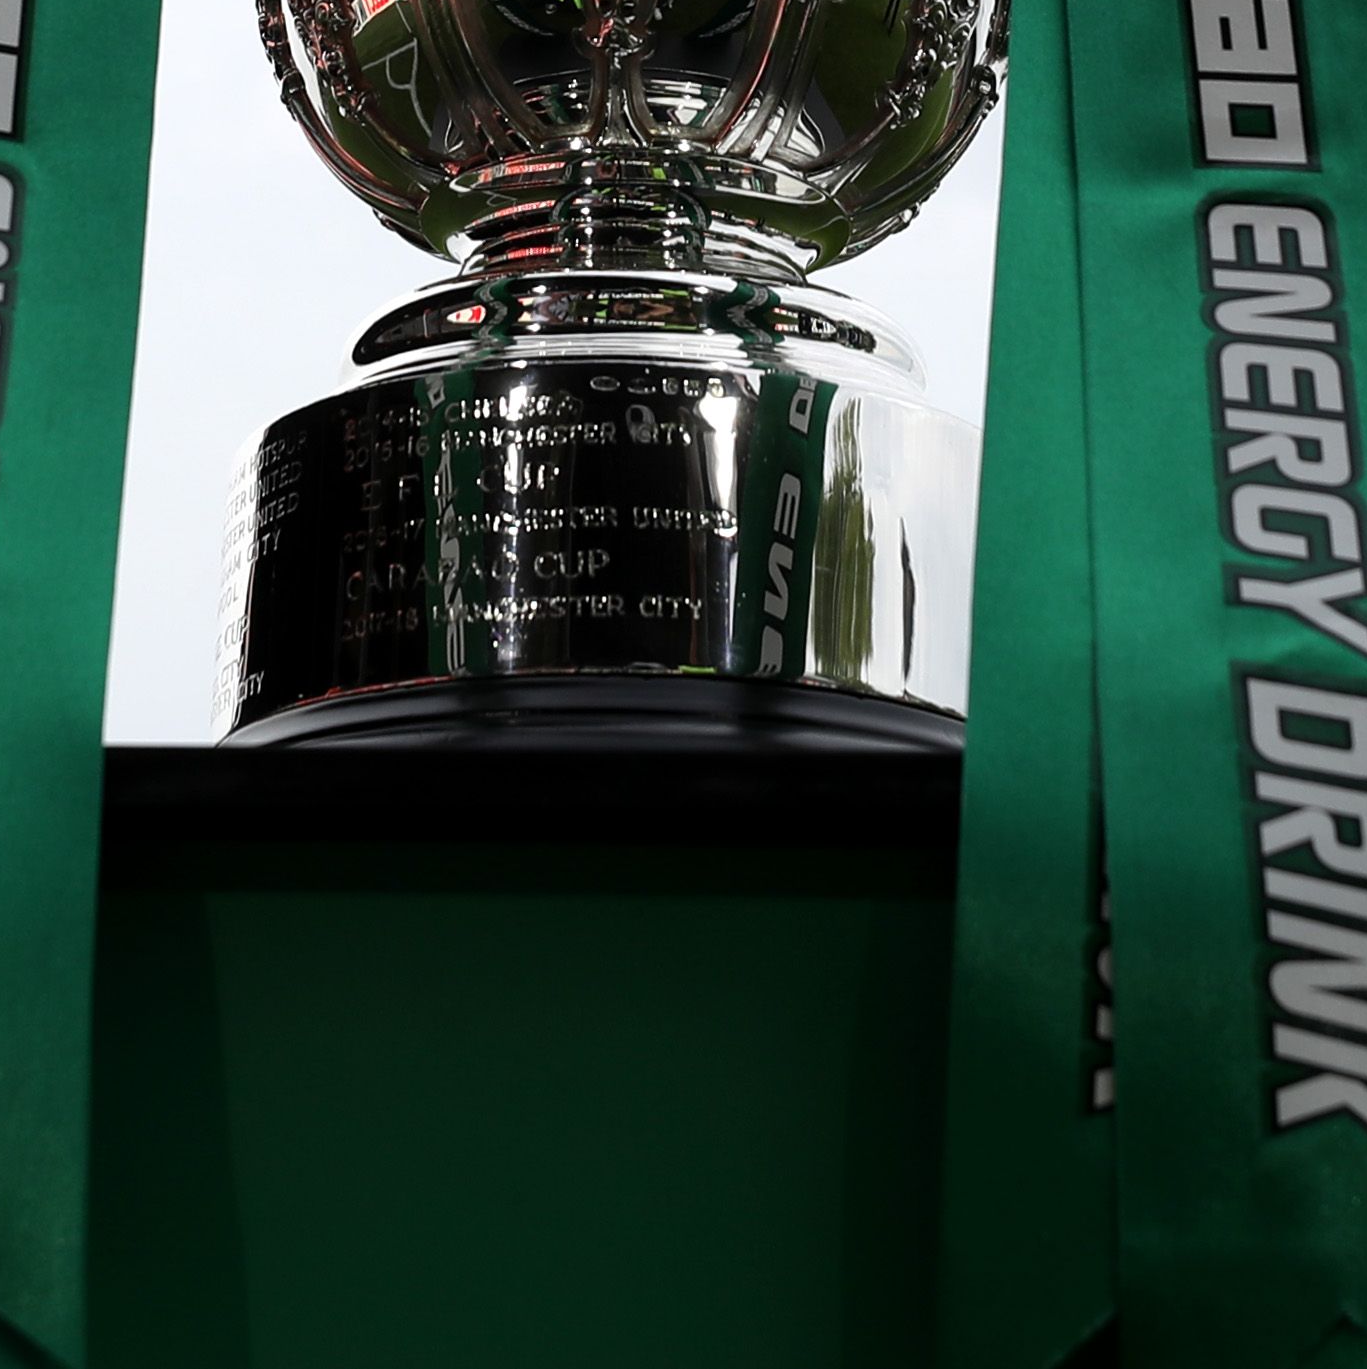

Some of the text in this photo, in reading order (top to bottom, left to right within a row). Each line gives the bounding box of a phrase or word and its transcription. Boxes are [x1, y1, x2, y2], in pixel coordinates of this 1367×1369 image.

[249, 461, 303, 503] UNITED
[247, 492, 300, 533] UNITED
[632, 507, 738, 538] UNITED
[246, 528, 281, 563] CITY
[534, 548, 611, 579] CUP
[433, 594, 625, 623] MANCHESTER
[638, 594, 702, 621] CITY
